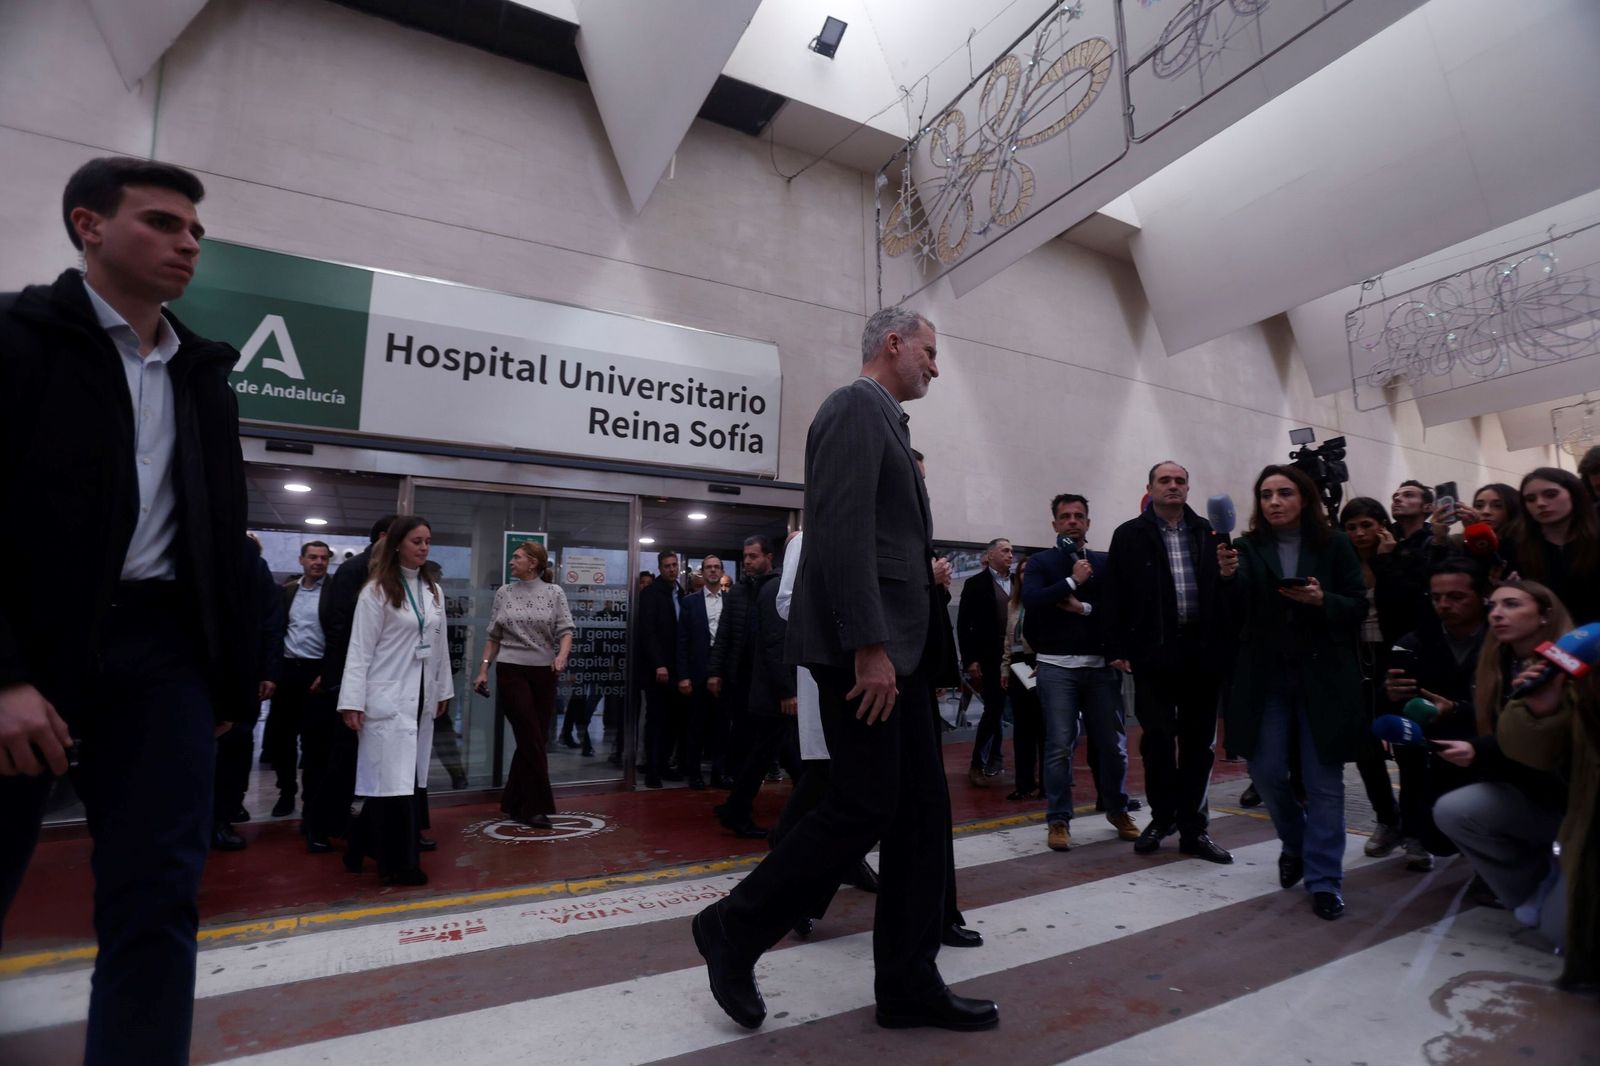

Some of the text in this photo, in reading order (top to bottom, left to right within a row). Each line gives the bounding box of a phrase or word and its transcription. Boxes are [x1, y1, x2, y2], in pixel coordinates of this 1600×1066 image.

[236, 380, 259, 394] de
[261, 383, 346, 404] Andalucía
[385, 332, 766, 415] Hospital Universitario
[588, 406, 764, 454] Reina Sofía
